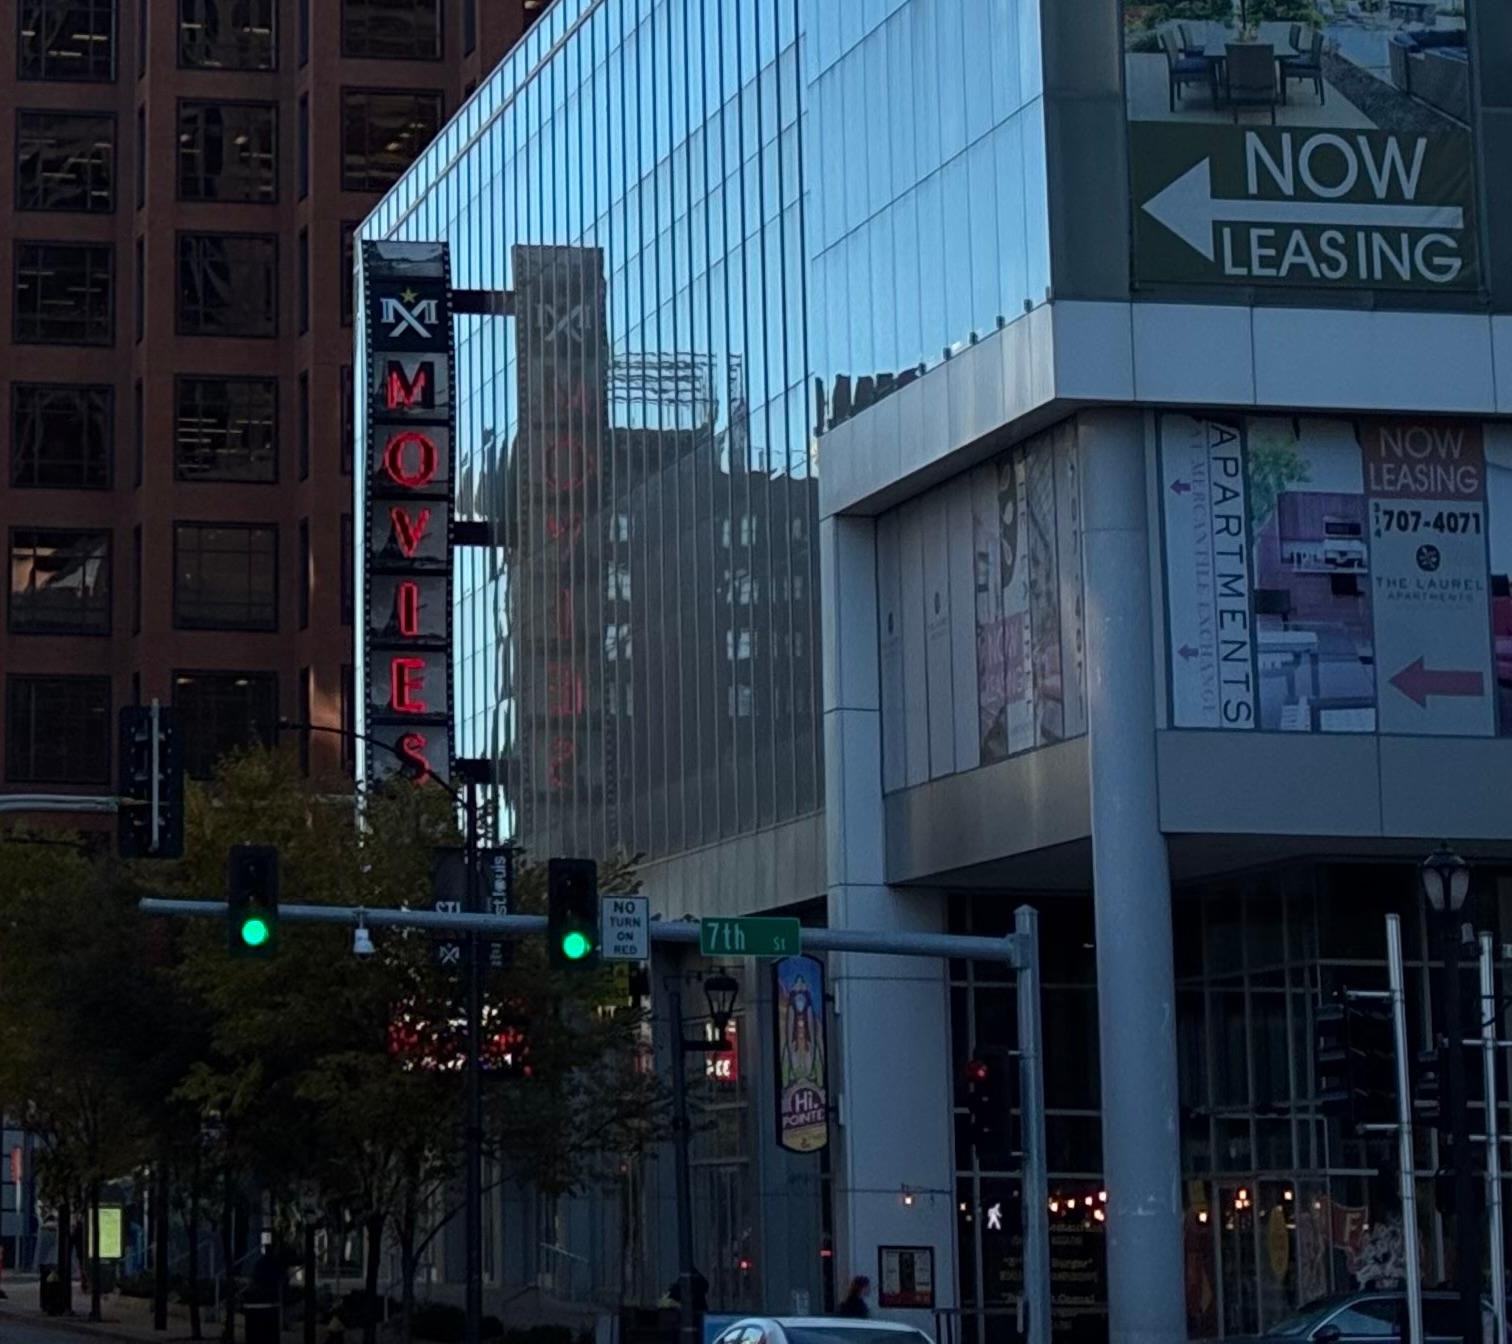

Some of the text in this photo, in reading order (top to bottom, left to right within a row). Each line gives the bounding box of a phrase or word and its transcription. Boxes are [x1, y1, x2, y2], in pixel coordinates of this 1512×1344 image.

[1244, 130, 1428, 201] NOW
[1221, 226, 1463, 283] LEASING
[1378, 425, 1465, 459] NOW
[1369, 463, 1479, 495] LEASING
[1373, 501, 1481, 539] 314 707-4071
[382, 360, 439, 785] MOVIES
[1210, 424, 1253, 724] APARTMENTS
[1376, 576, 1484, 592] THE LAUREL
[1386, 589, 1474, 602] APARTMENTS
[610, 916, 641, 929] TURN
[613, 901, 635, 915] NO
[613, 944, 637, 955] RED
[616, 931, 634, 942] ON
[707, 922, 786, 951] 7th St
